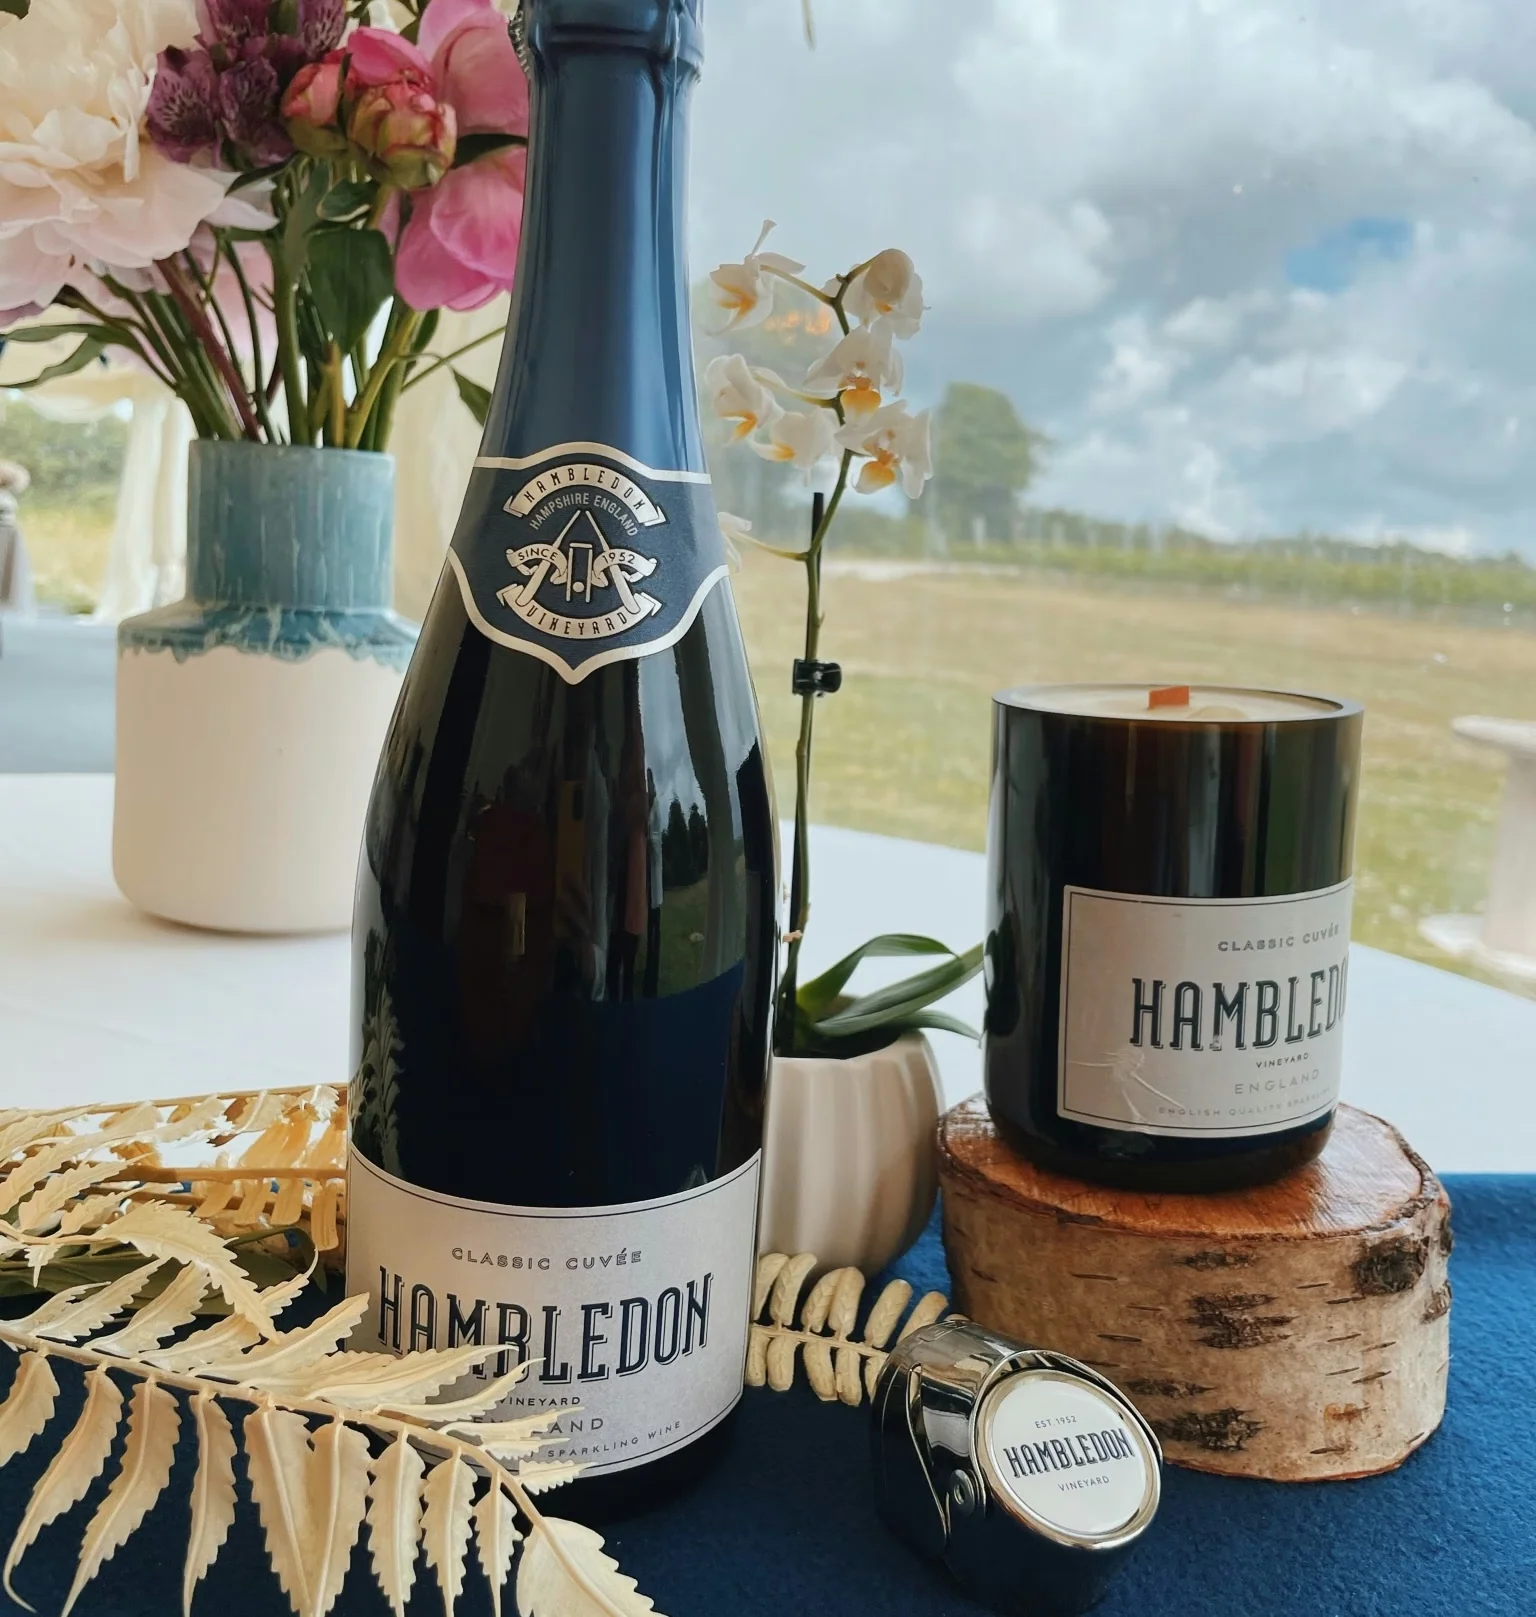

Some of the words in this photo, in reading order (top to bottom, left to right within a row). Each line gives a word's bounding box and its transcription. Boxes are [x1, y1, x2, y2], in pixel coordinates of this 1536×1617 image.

[523, 468, 646, 510] HAMBLEDON
[529, 492, 590, 531] HAMPSHIRE
[593, 495, 639, 537] ENGLAND
[517, 548, 558, 562] SINCE
[602, 553, 635, 565] 1952
[526, 607, 628, 636] VINEYARD
[1217, 936, 1295, 952] CLASSIC
[1129, 951, 1349, 1052] HAMBLEDO
[1256, 1052, 1310, 1069] VINEYARD
[1234, 1068, 1320, 1095] ENGLAND
[451, 1247, 550, 1270] CLASSIC
[565, 1248, 643, 1271] CUVÉE
[378, 1265, 714, 1385] HAMBLEDON
[547, 1437, 639, 1458] SPARKLING
[647, 1420, 682, 1440] WINE
[1003, 1428, 1136, 1479] HAMBLEDON
[1058, 1475, 1111, 1492] VINEYARD
